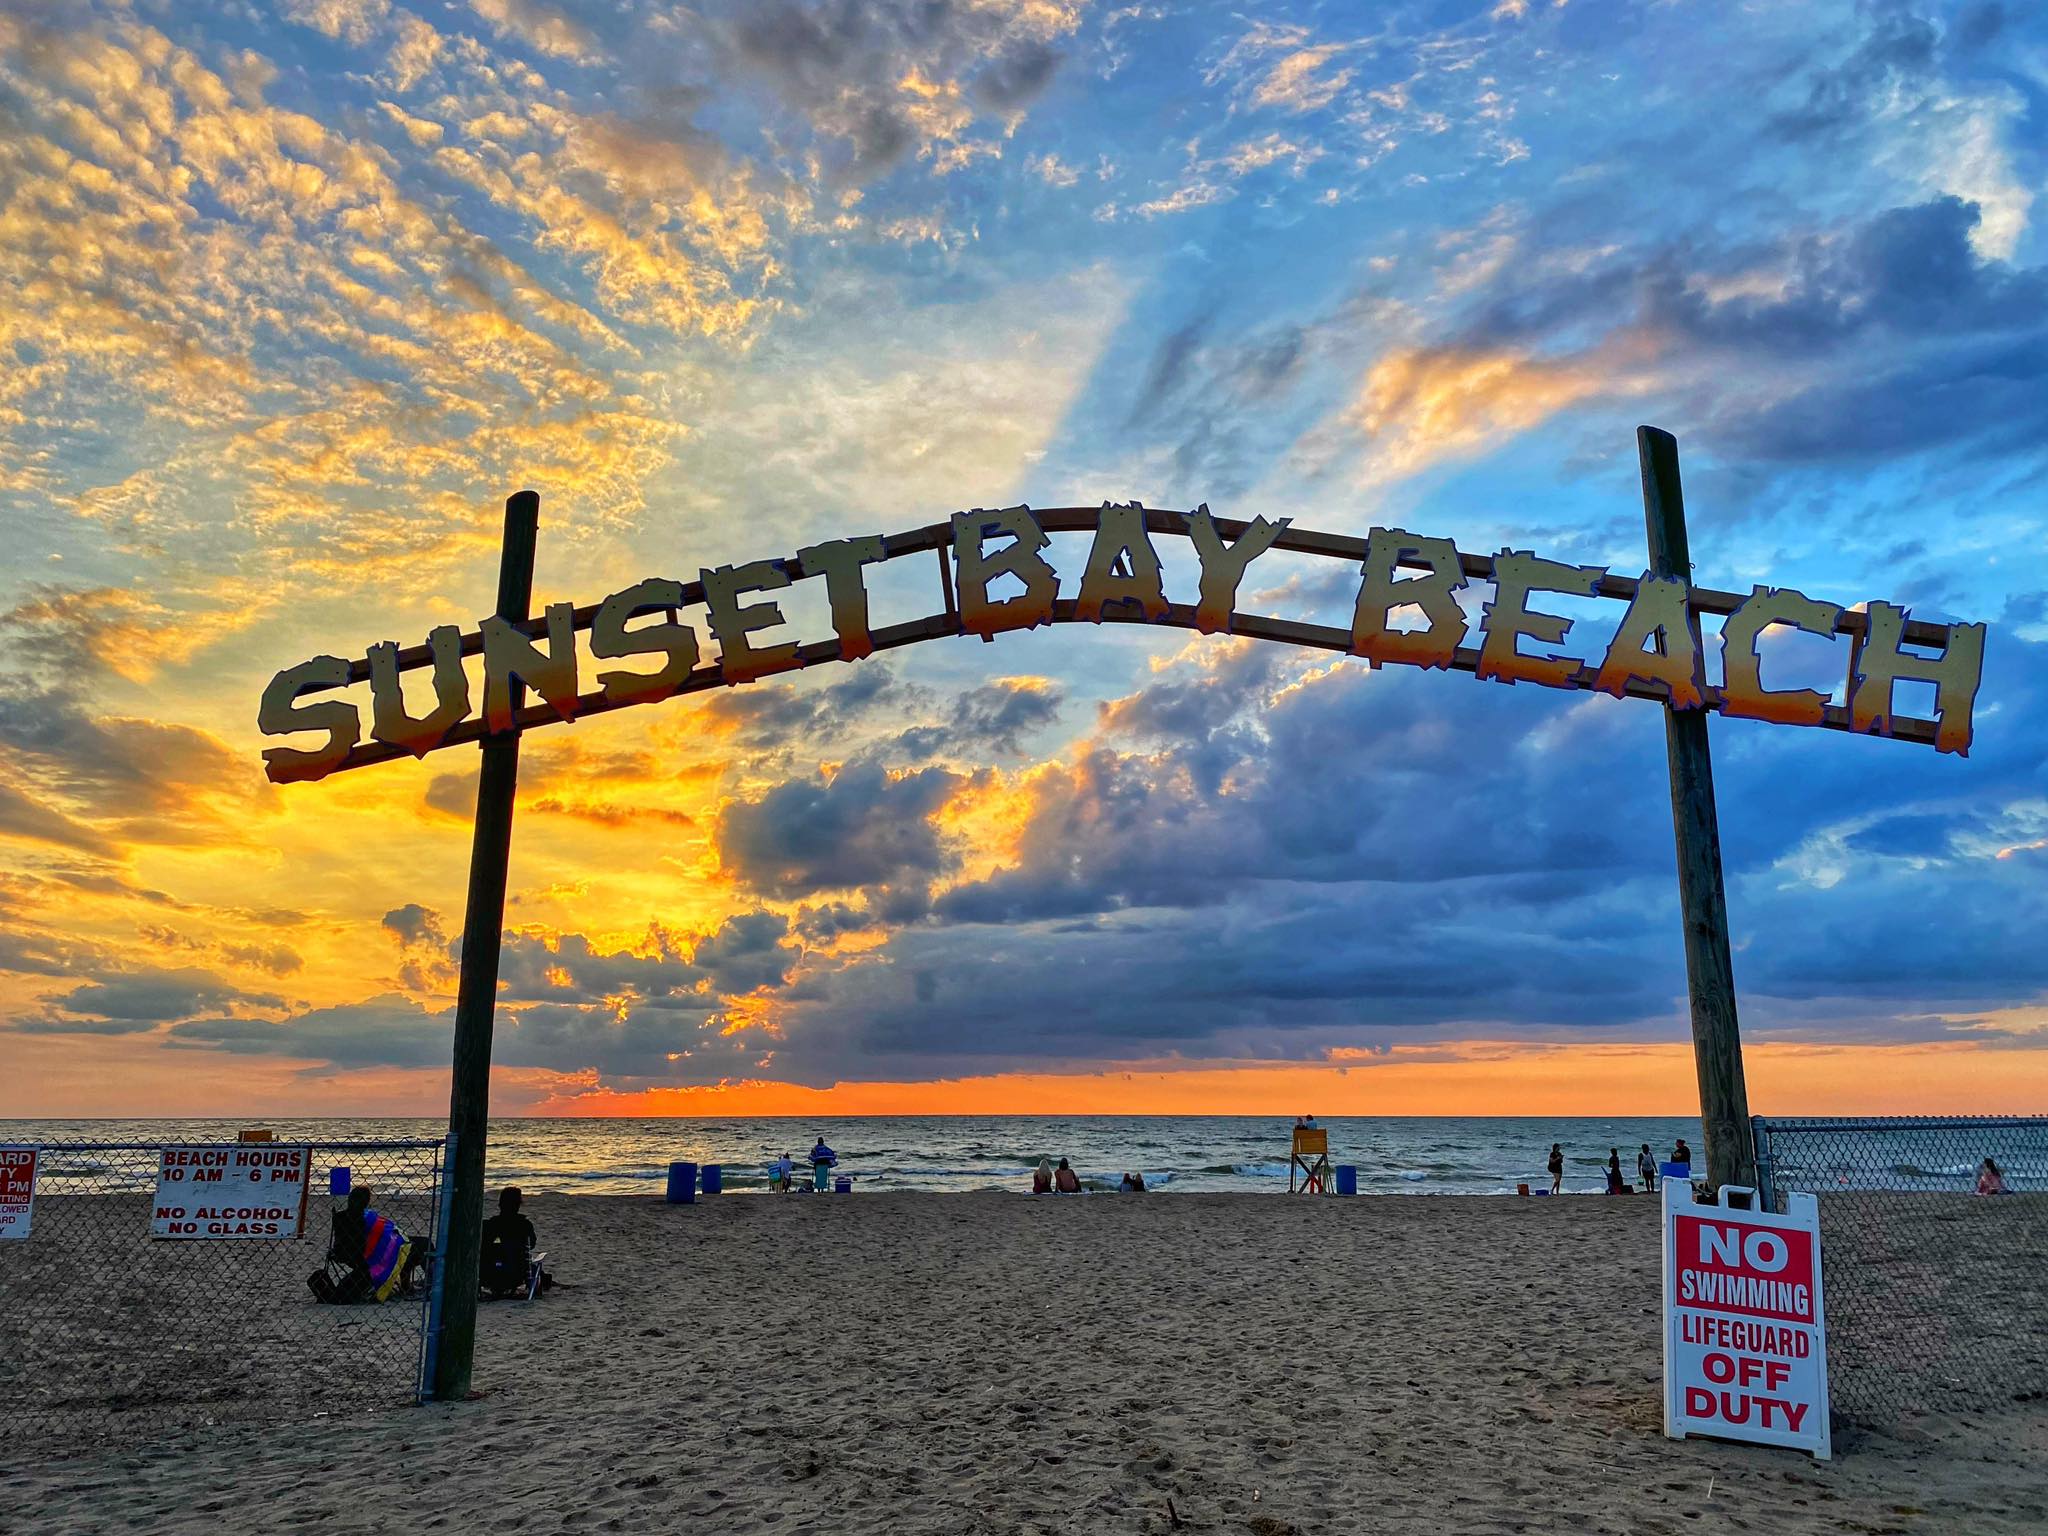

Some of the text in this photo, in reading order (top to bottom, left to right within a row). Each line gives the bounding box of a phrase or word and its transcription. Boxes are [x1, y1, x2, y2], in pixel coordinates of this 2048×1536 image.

[257, 501, 1988, 784] SUNSET BAY BEACH
[163, 1151, 302, 1167] BEACH HOURS
[163, 1169, 184, 1181] 10
[192, 1169, 223, 1182] AM
[250, 1169, 262, 1182] 6
[271, 1169, 300, 1182] PM
[7, 1181, 30, 1193] PM
[0, 1205, 29, 1214] OWED
[156, 1207, 294, 1219] NO ALCOHOL
[0, 1216, 16, 1224] RD
[168, 1223, 278, 1234] NO GLASS
[1699, 1223, 1789, 1273] NO
[1681, 1268, 1809, 1316] SWIMMING
[1682, 1314, 1810, 1359] LIFEGUARD
[1702, 1352, 1791, 1391] OFF
[1685, 1386, 1809, 1433] DUTY
